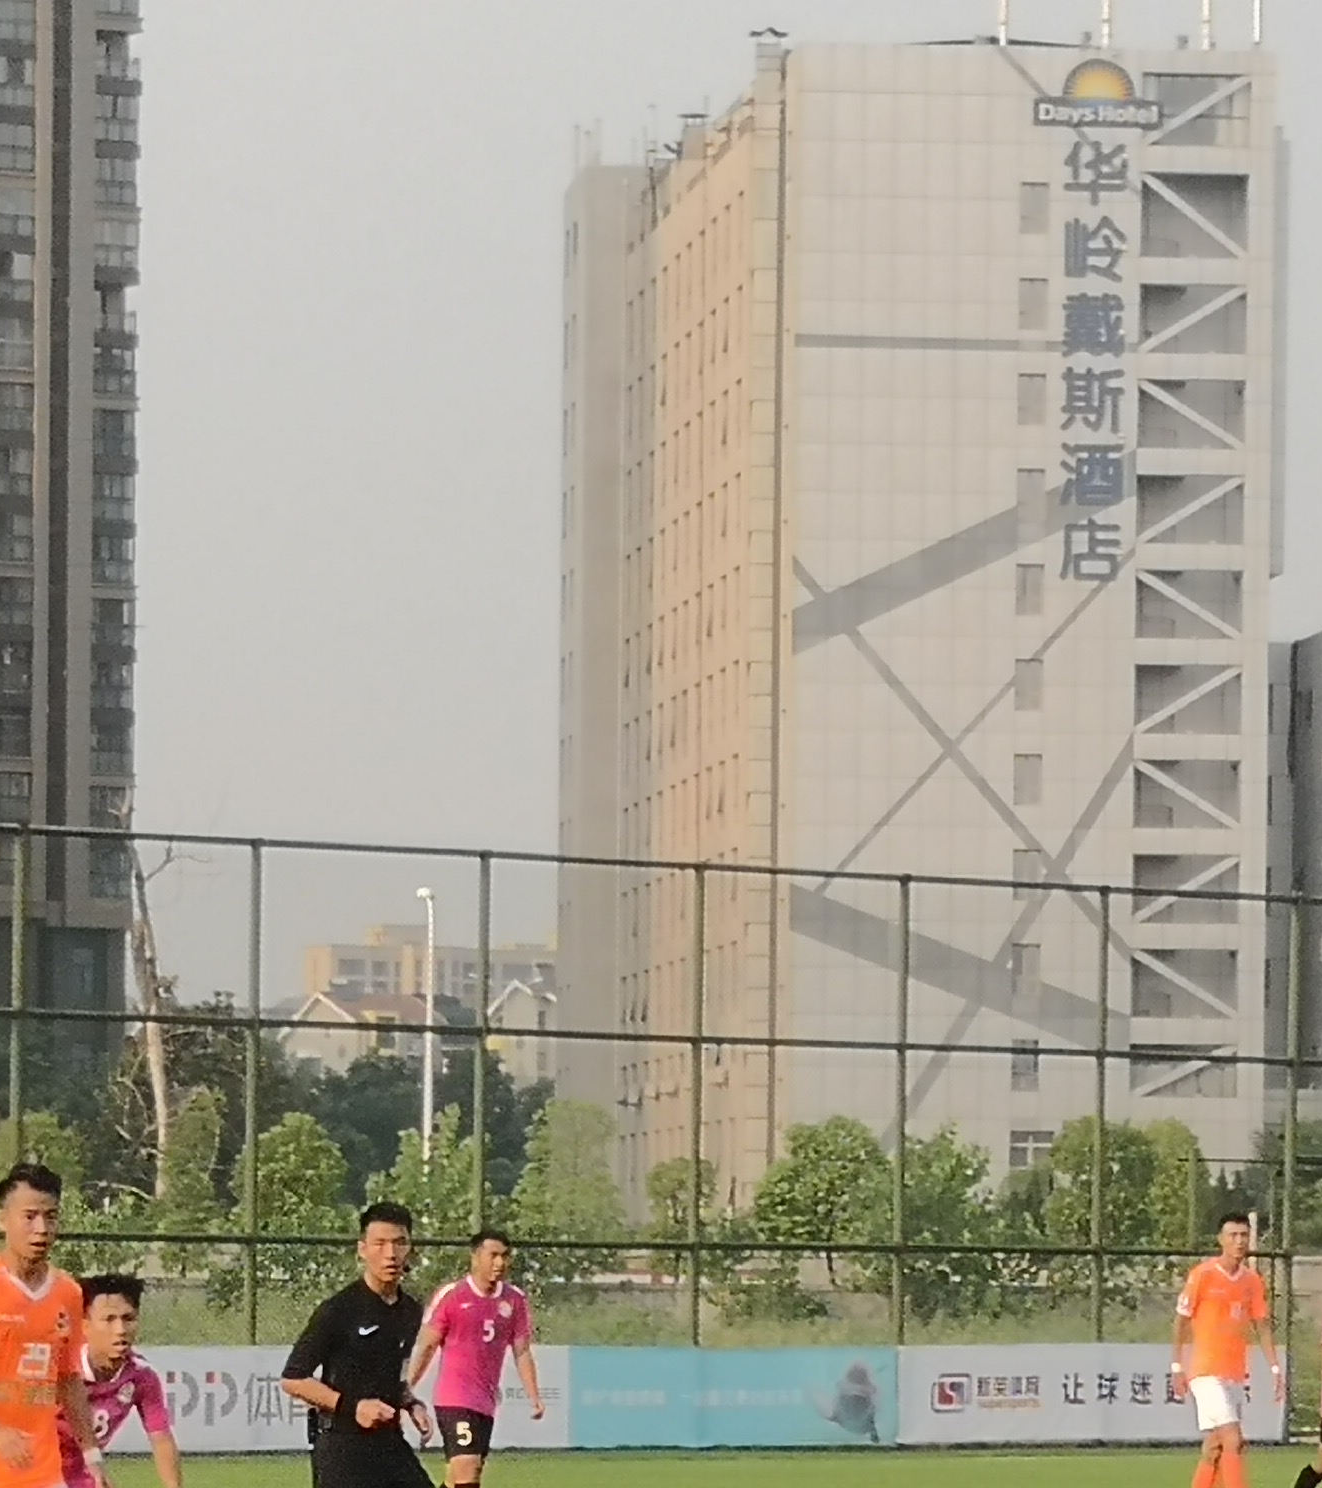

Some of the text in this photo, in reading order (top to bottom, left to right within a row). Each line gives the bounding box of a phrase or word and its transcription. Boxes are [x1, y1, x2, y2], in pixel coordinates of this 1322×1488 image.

[1038, 103, 1096, 123] Days
[1060, 139, 1128, 582] 华岭戴斯酒店
[482, 1319, 496, 1343] 5
[456, 1421, 473, 1446] 5
